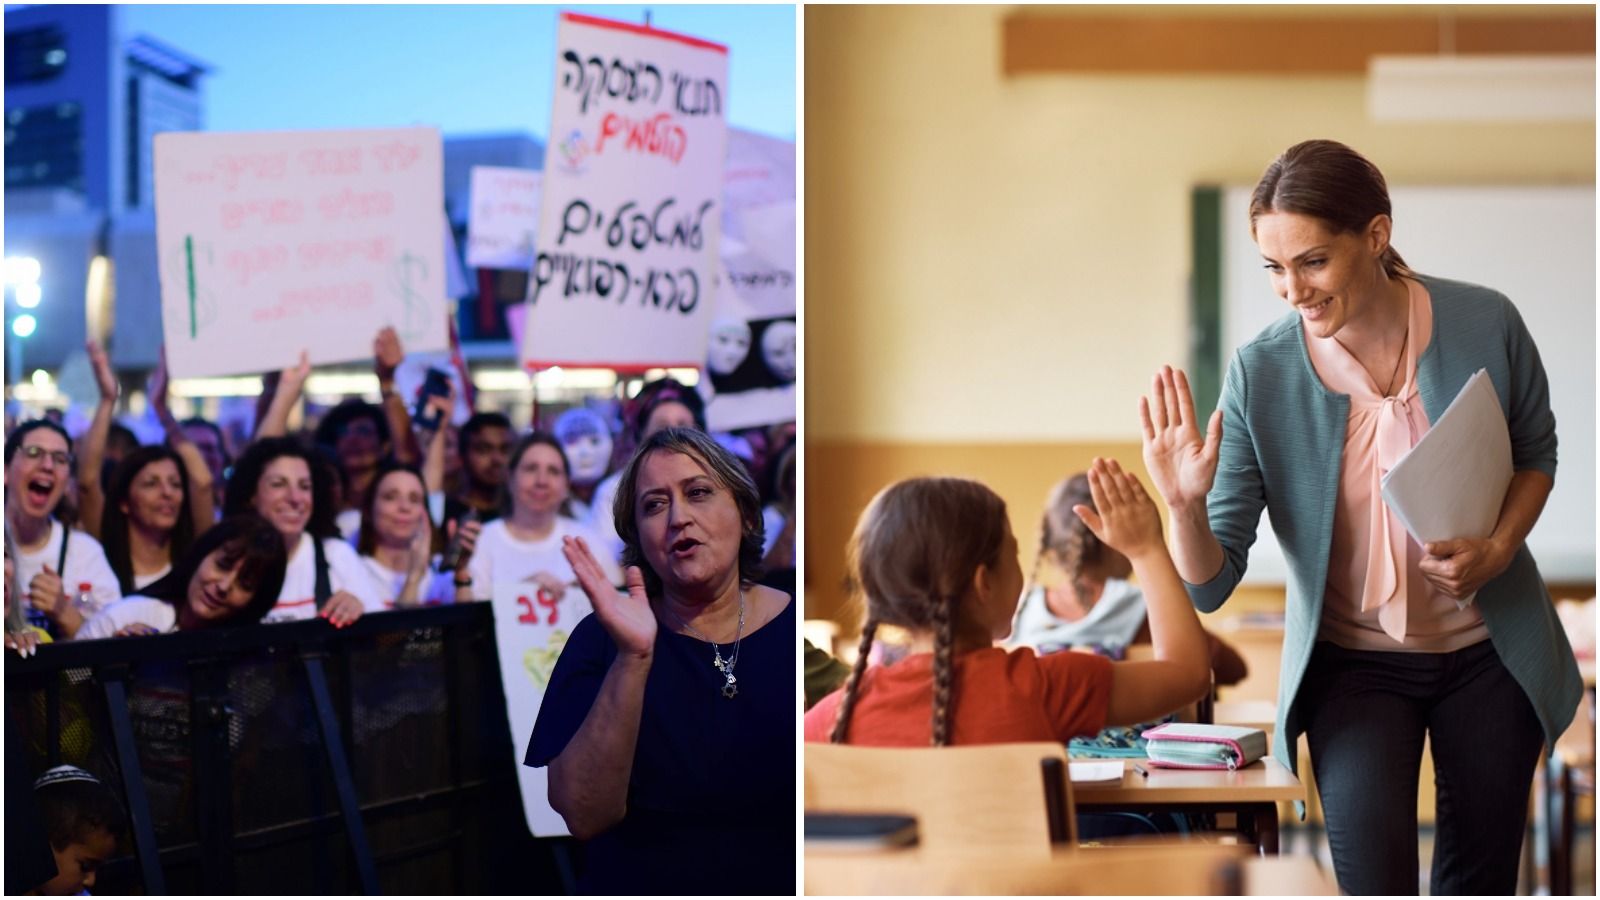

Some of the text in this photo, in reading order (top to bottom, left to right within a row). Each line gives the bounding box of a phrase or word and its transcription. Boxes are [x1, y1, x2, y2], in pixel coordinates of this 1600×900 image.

[561, 50, 720, 116] תנאי העסקה
[594, 111, 688, 165] הולמים
[556, 197, 714, 252] למטפלים
